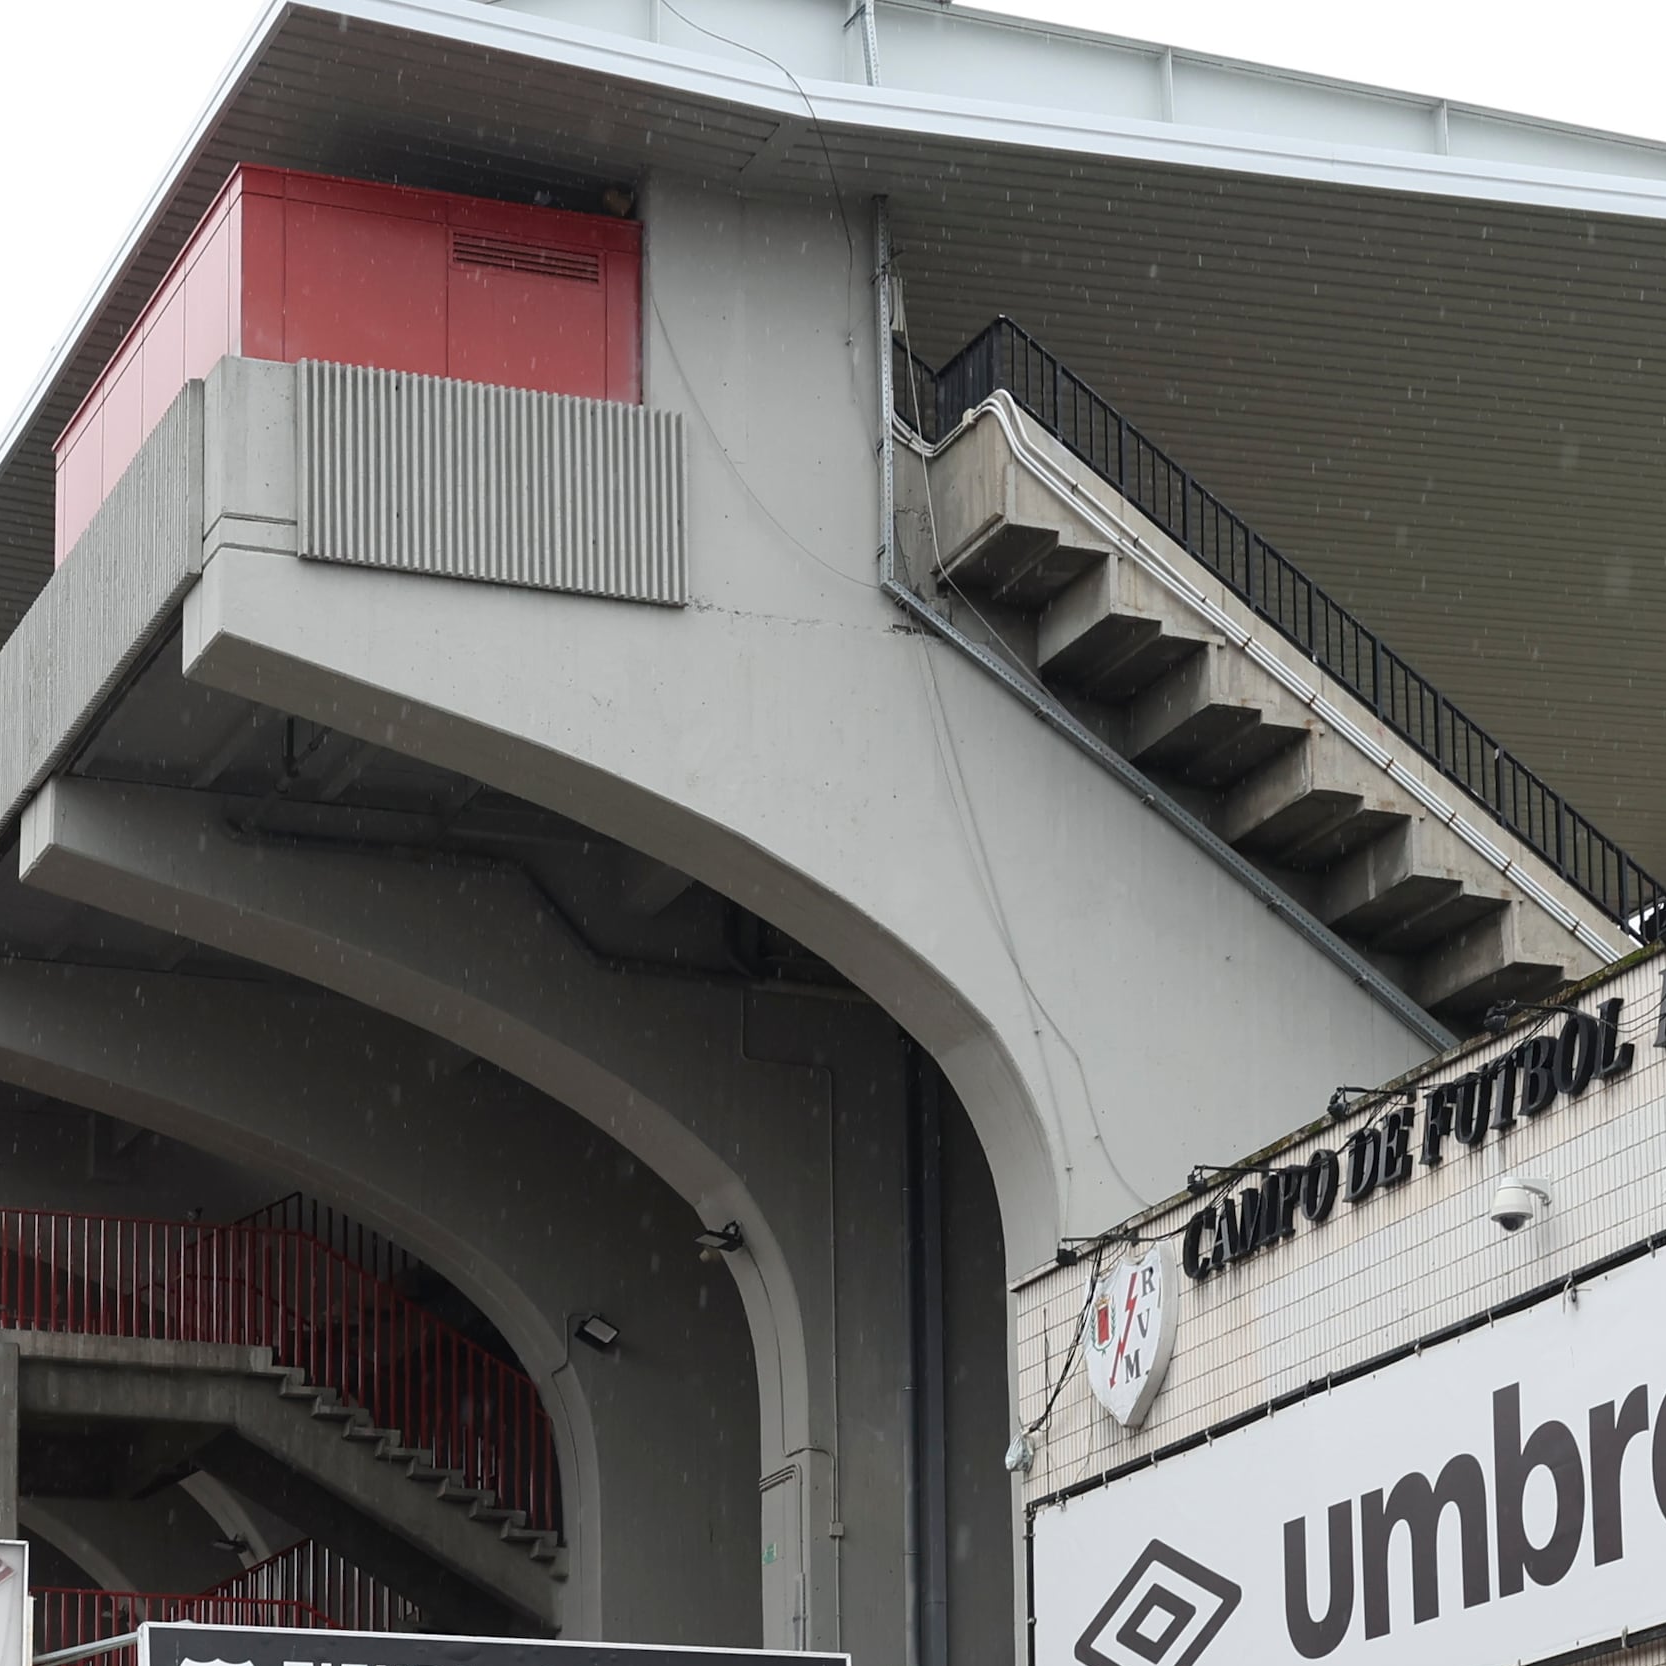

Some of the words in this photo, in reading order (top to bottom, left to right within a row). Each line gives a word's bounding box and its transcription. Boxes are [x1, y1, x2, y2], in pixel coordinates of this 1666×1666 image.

[1183, 1149, 1340, 1280] CAMPO
[1342, 1107, 1415, 1203] DE
[1418, 998, 1635, 1166] FUTBOL
